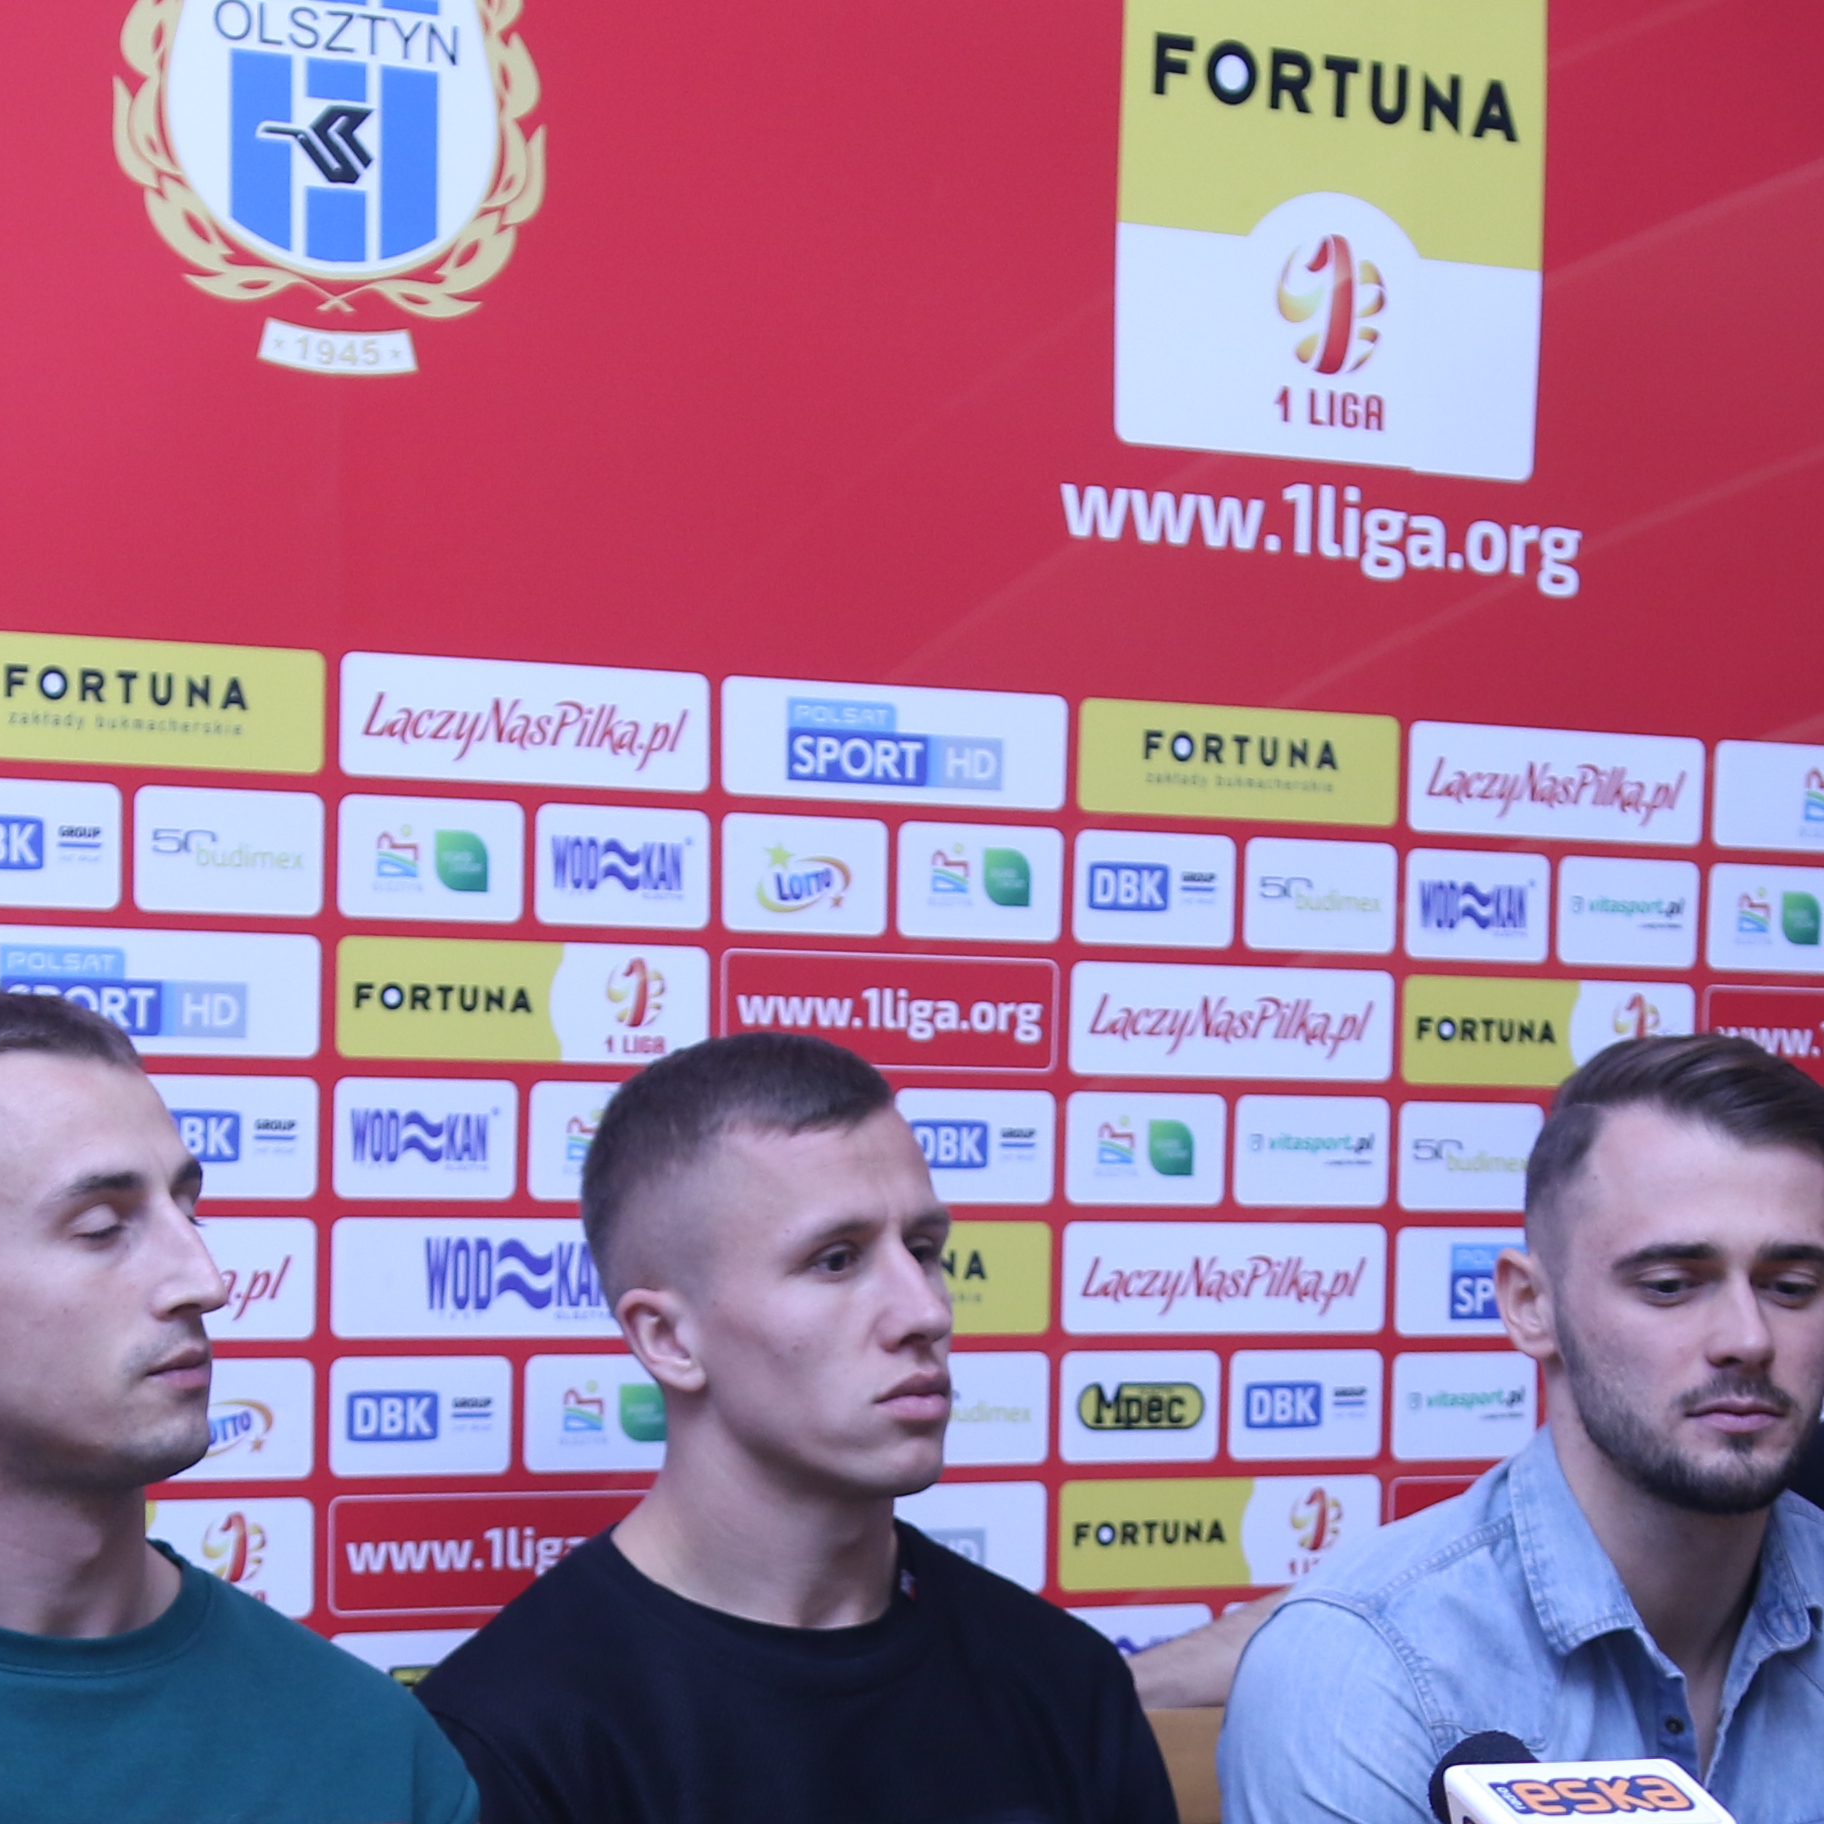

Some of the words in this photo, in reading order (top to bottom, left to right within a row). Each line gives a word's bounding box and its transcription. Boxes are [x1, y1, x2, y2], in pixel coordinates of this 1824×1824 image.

[215, 0, 459, 65] OLSZTYN
[1153, 32, 1518, 141] FORTUNA
[297, 336, 380, 368] 1945
[1274, 386, 1291, 421] 1
[1309, 388, 1384, 431] LIGA
[1060, 482, 1581, 597] www.1liga.org
[4, 663, 247, 711] FORTUNA
[792, 736, 924, 779] SPORT
[945, 747, 998, 780] HD
[1144, 730, 1338, 770] FORTUNA
[1094, 869, 1163, 905] DBK
[182, 993, 238, 1028] HD
[354, 983, 533, 1013] FORTUNA
[736, 987, 1044, 1043] www.1liga.org
[1417, 1018, 1555, 1044] FORTUNA
[355, 1397, 433, 1436] DBK
[1250, 1388, 1317, 1423] DBK
[1073, 1521, 1226, 1547] FORTUNA
